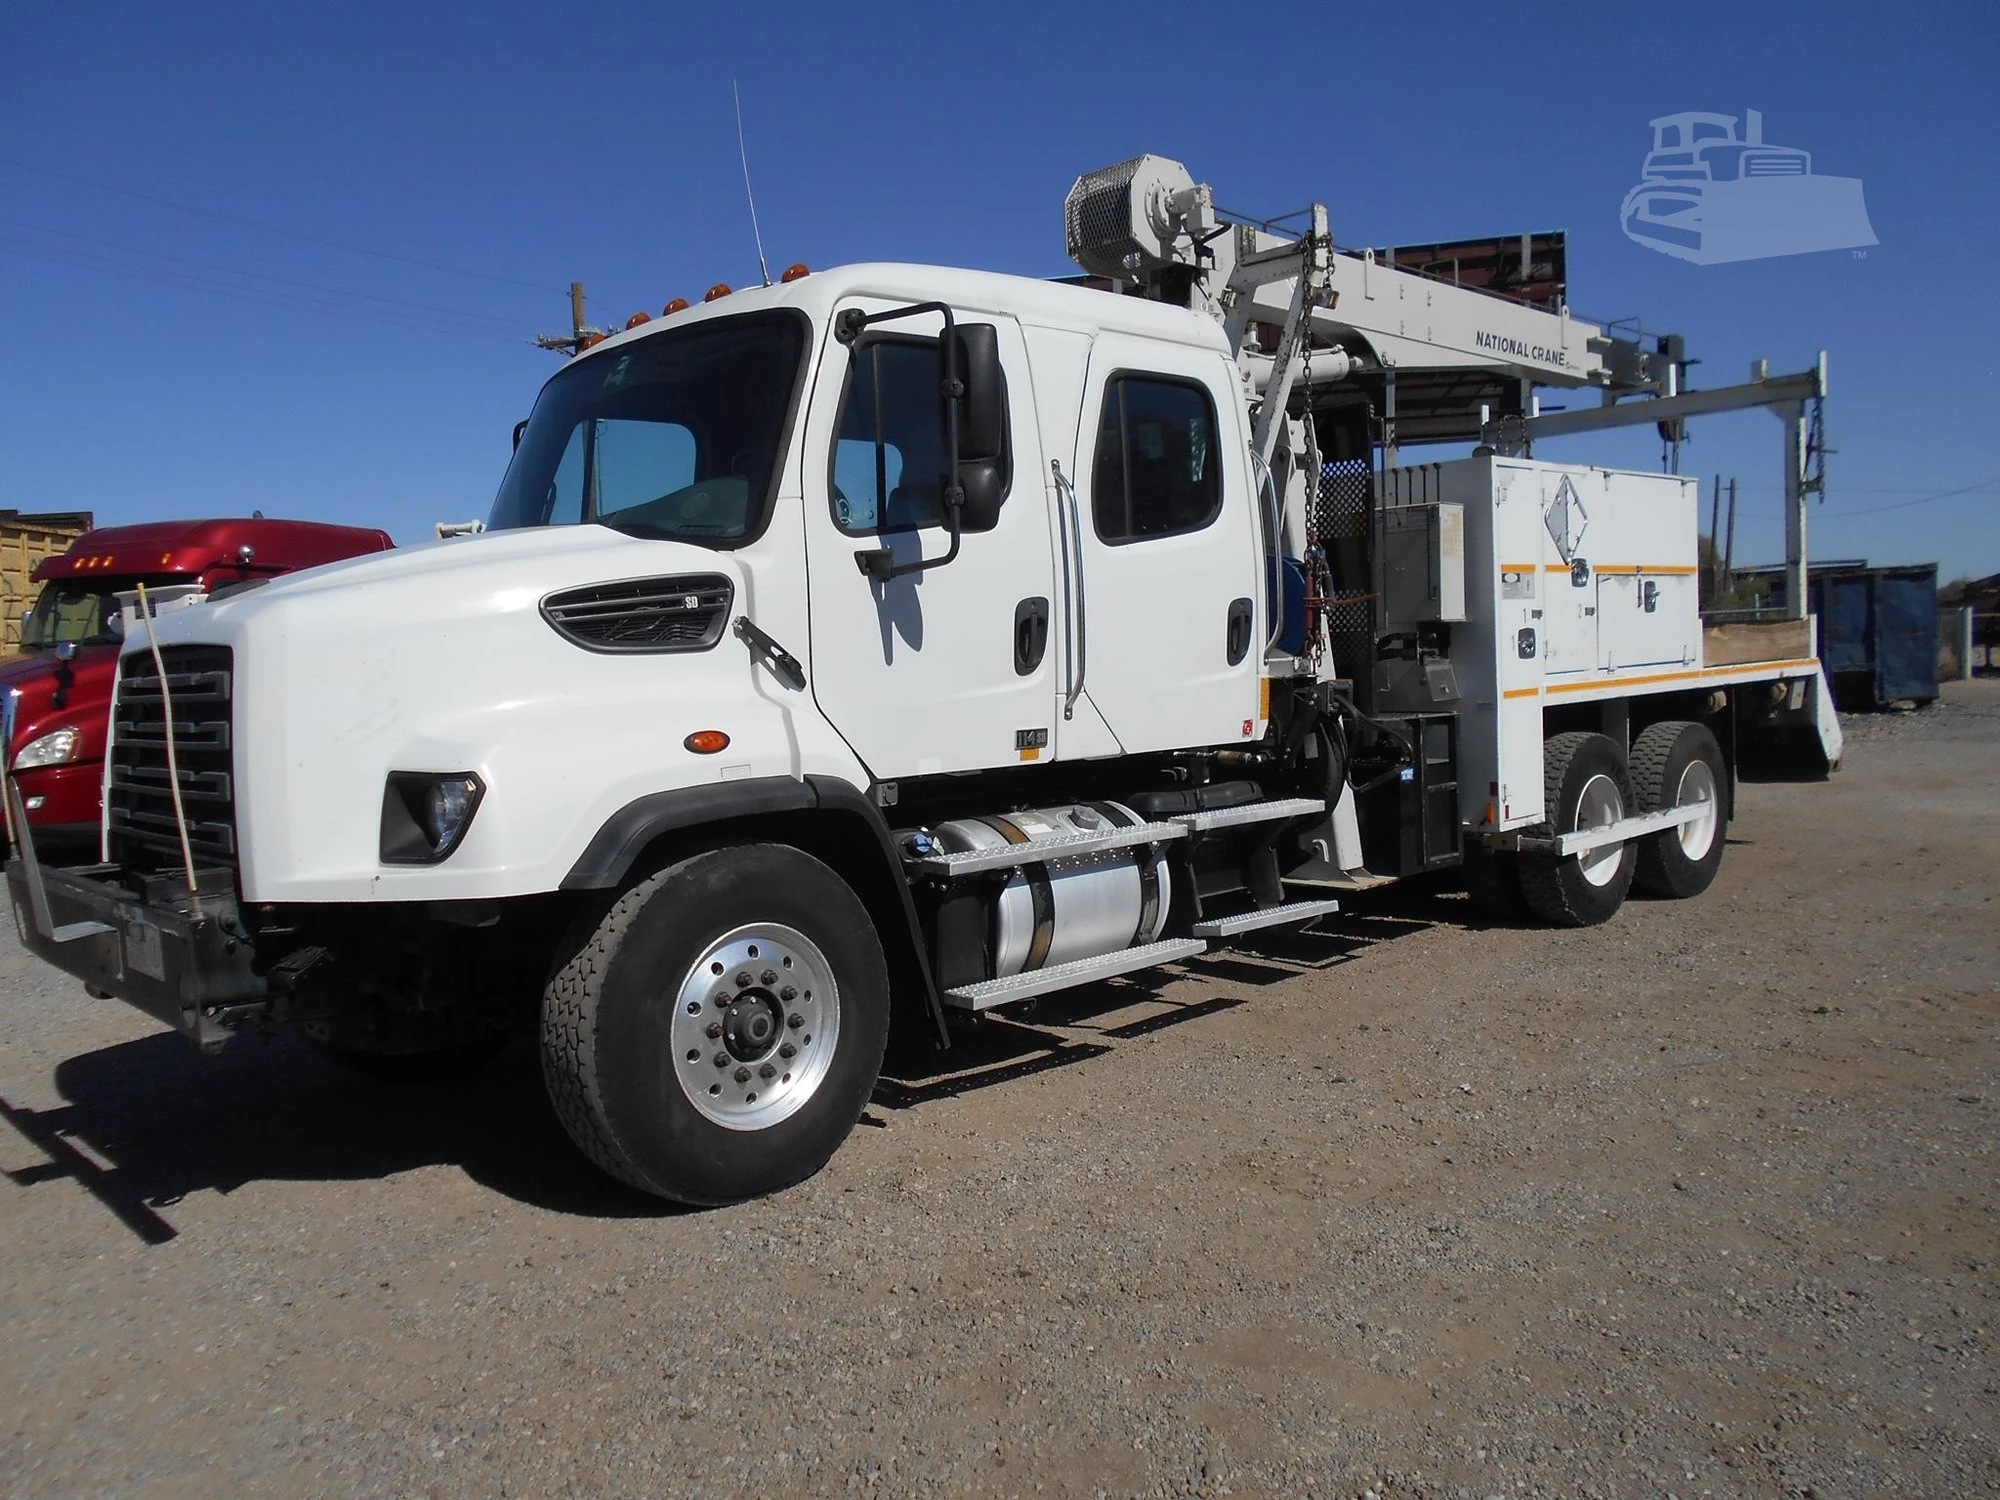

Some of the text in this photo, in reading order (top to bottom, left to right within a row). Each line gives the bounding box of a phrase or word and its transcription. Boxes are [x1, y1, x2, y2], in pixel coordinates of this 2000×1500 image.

[1476, 330, 1565, 367] NATIONAL CRANE
[685, 596, 699, 609] SD
